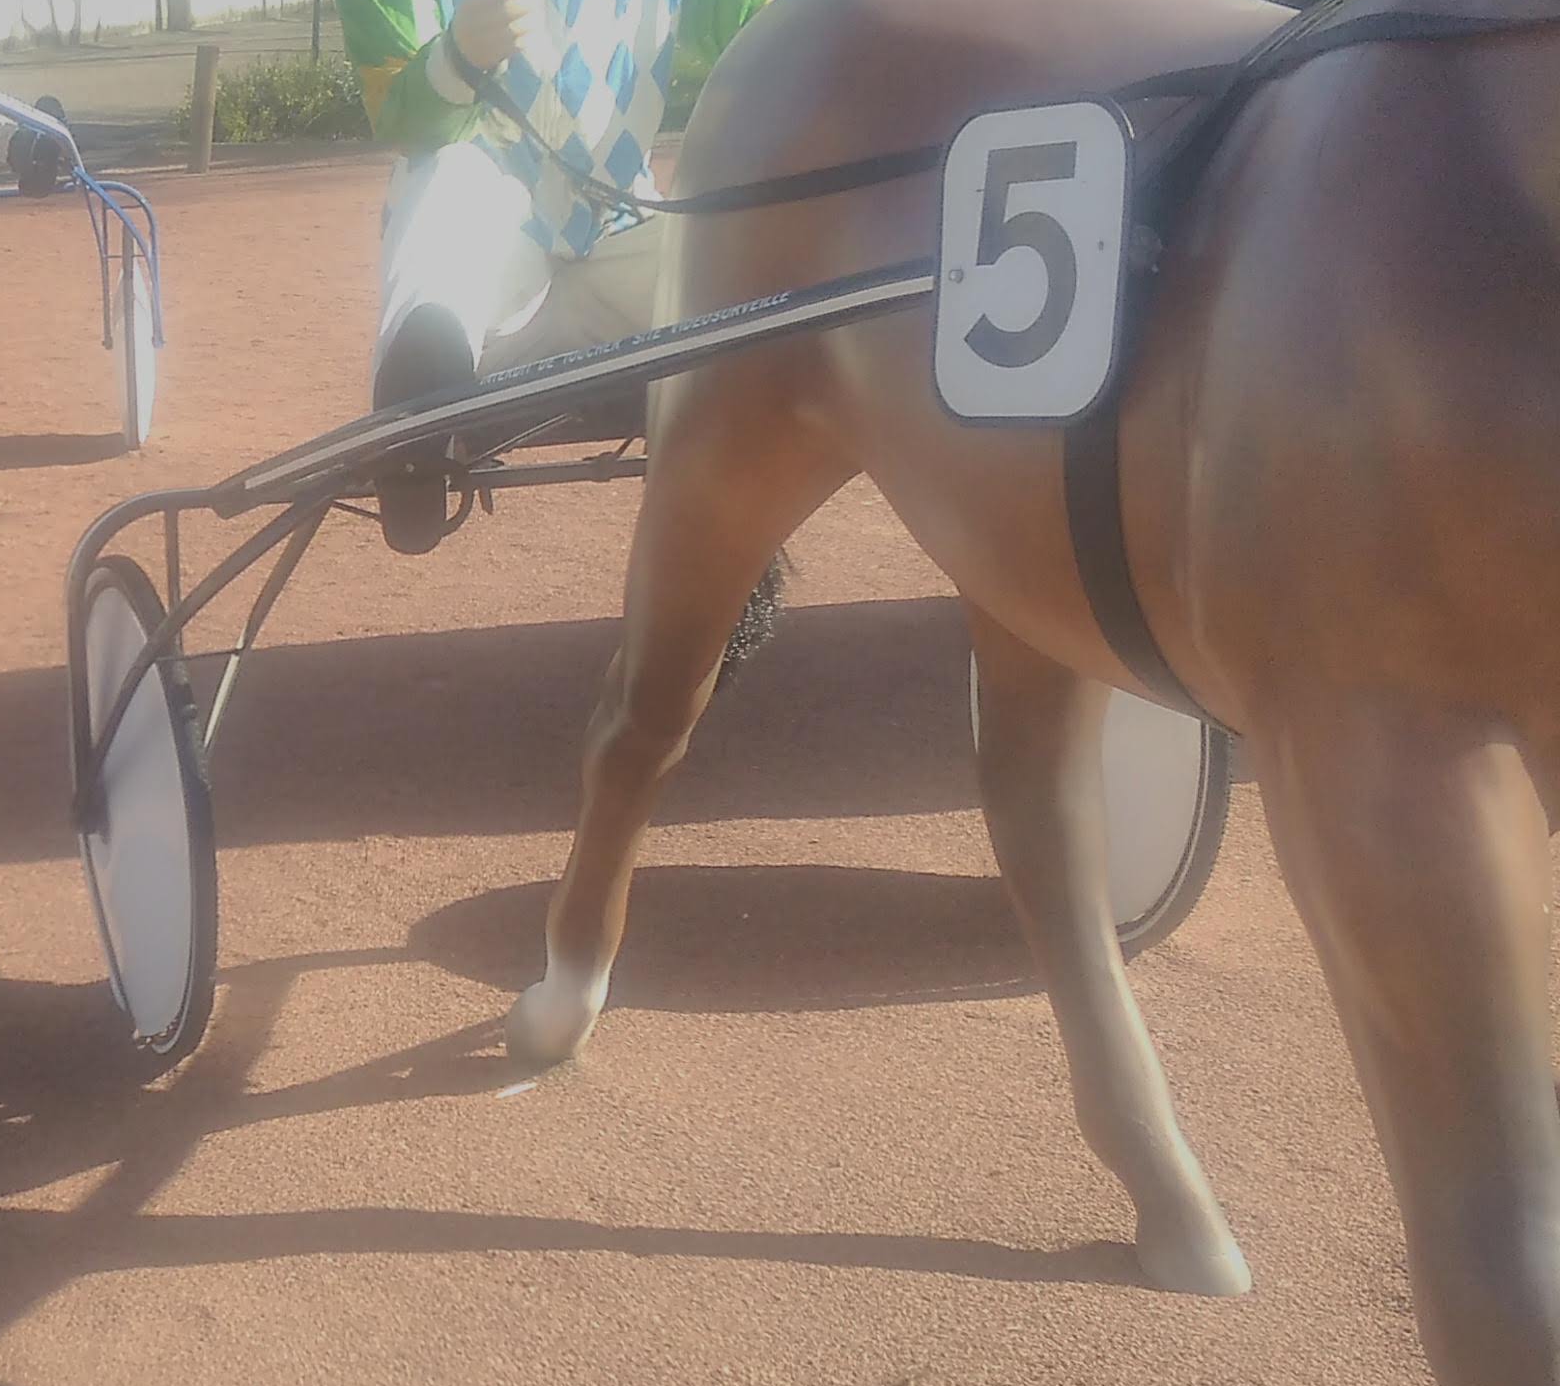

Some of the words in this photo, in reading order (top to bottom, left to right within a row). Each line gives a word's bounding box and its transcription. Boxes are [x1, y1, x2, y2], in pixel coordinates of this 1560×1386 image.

[964, 141, 1077, 368] 5
[480, 365, 531, 386] INTERDIT
[537, 359, 555, 371] DE
[563, 342, 621, 365] TOUCHER
[632, 330, 661, 345] SITE
